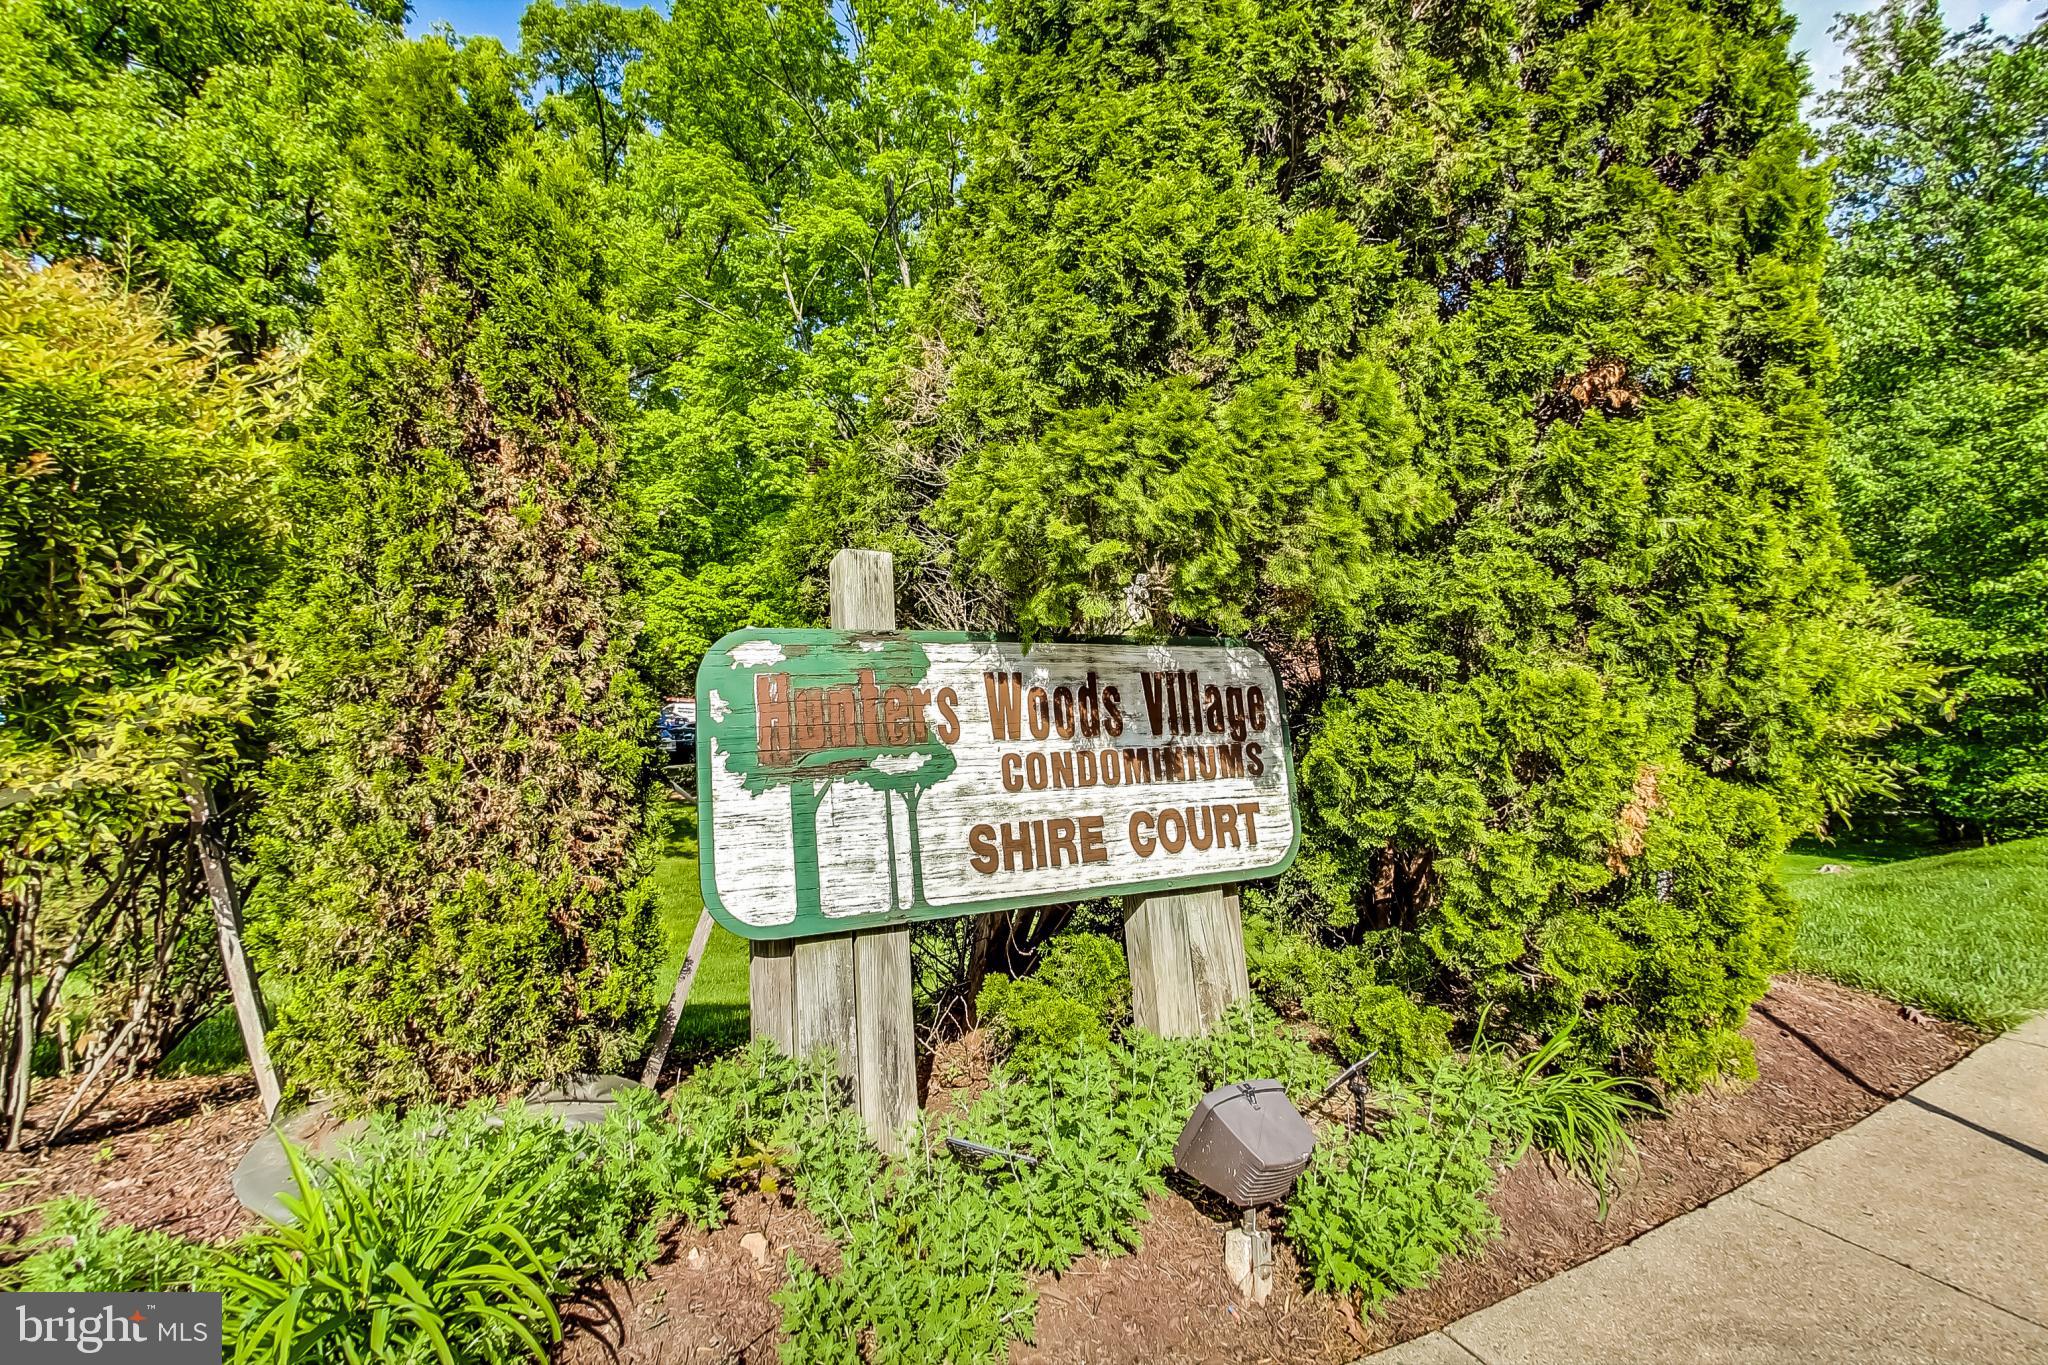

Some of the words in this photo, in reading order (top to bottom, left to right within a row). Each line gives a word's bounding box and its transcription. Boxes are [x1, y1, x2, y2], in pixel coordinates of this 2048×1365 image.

[754, 668, 961, 766] Hunters
[983, 671, 1123, 741] Woods
[1140, 669, 1267, 742] Village
[1001, 742, 1264, 792] CONDOMINIUMS
[968, 815, 1108, 874] SHIRE
[1129, 802, 1260, 858] COURT
